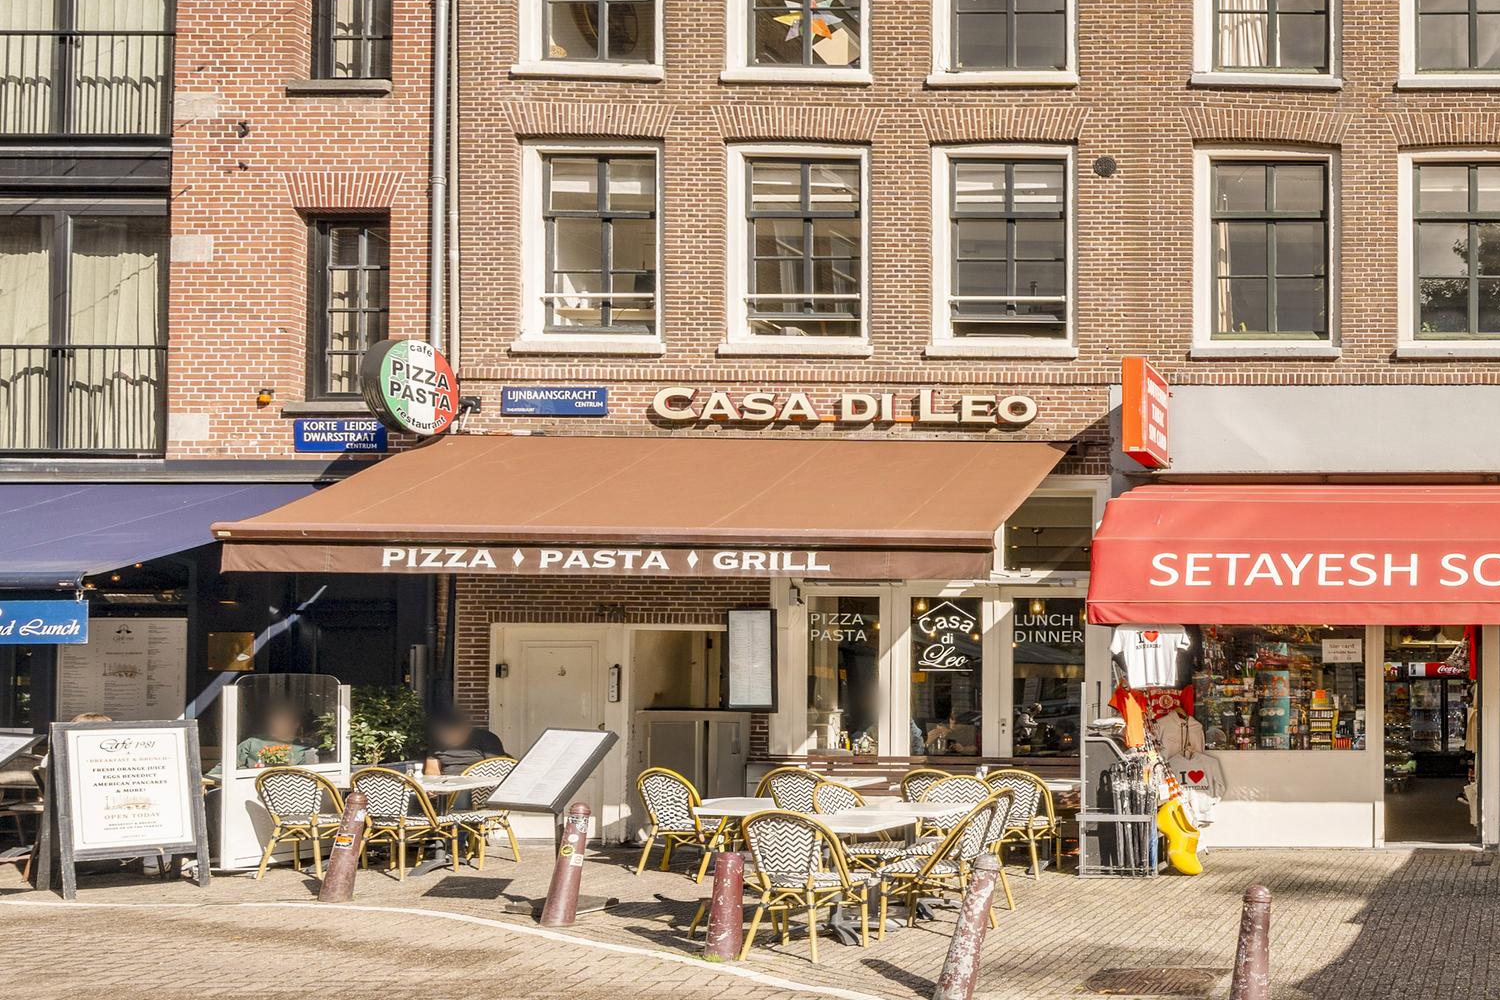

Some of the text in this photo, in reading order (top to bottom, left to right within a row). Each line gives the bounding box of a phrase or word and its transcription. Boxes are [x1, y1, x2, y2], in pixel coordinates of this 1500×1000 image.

[391, 360, 450, 391] PIZZA
[389, 380, 452, 412] PASTA
[507, 390, 597, 402] LIJNBAANSGRACHT
[396, 407, 446, 430] restaurant
[303, 421, 377, 431] KORTE LEIDSE
[303, 432, 376, 442] DWARSSTRAAT
[381, 548, 830, 571] PIZZA PASTA GRILL
[1149, 552, 1418, 587] SETAYESH
[810, 613, 864, 625] PIZZA
[918, 614, 974, 635] Casa
[1014, 614, 1074, 627] LUNCH
[19, 618, 81, 636] Lunch
[810, 630, 868, 642] PASTA
[941, 632, 954, 645] di
[1014, 630, 1084, 643] DINNER
[918, 643, 969, 668] Leo
[100, 738, 133, 752] Café
